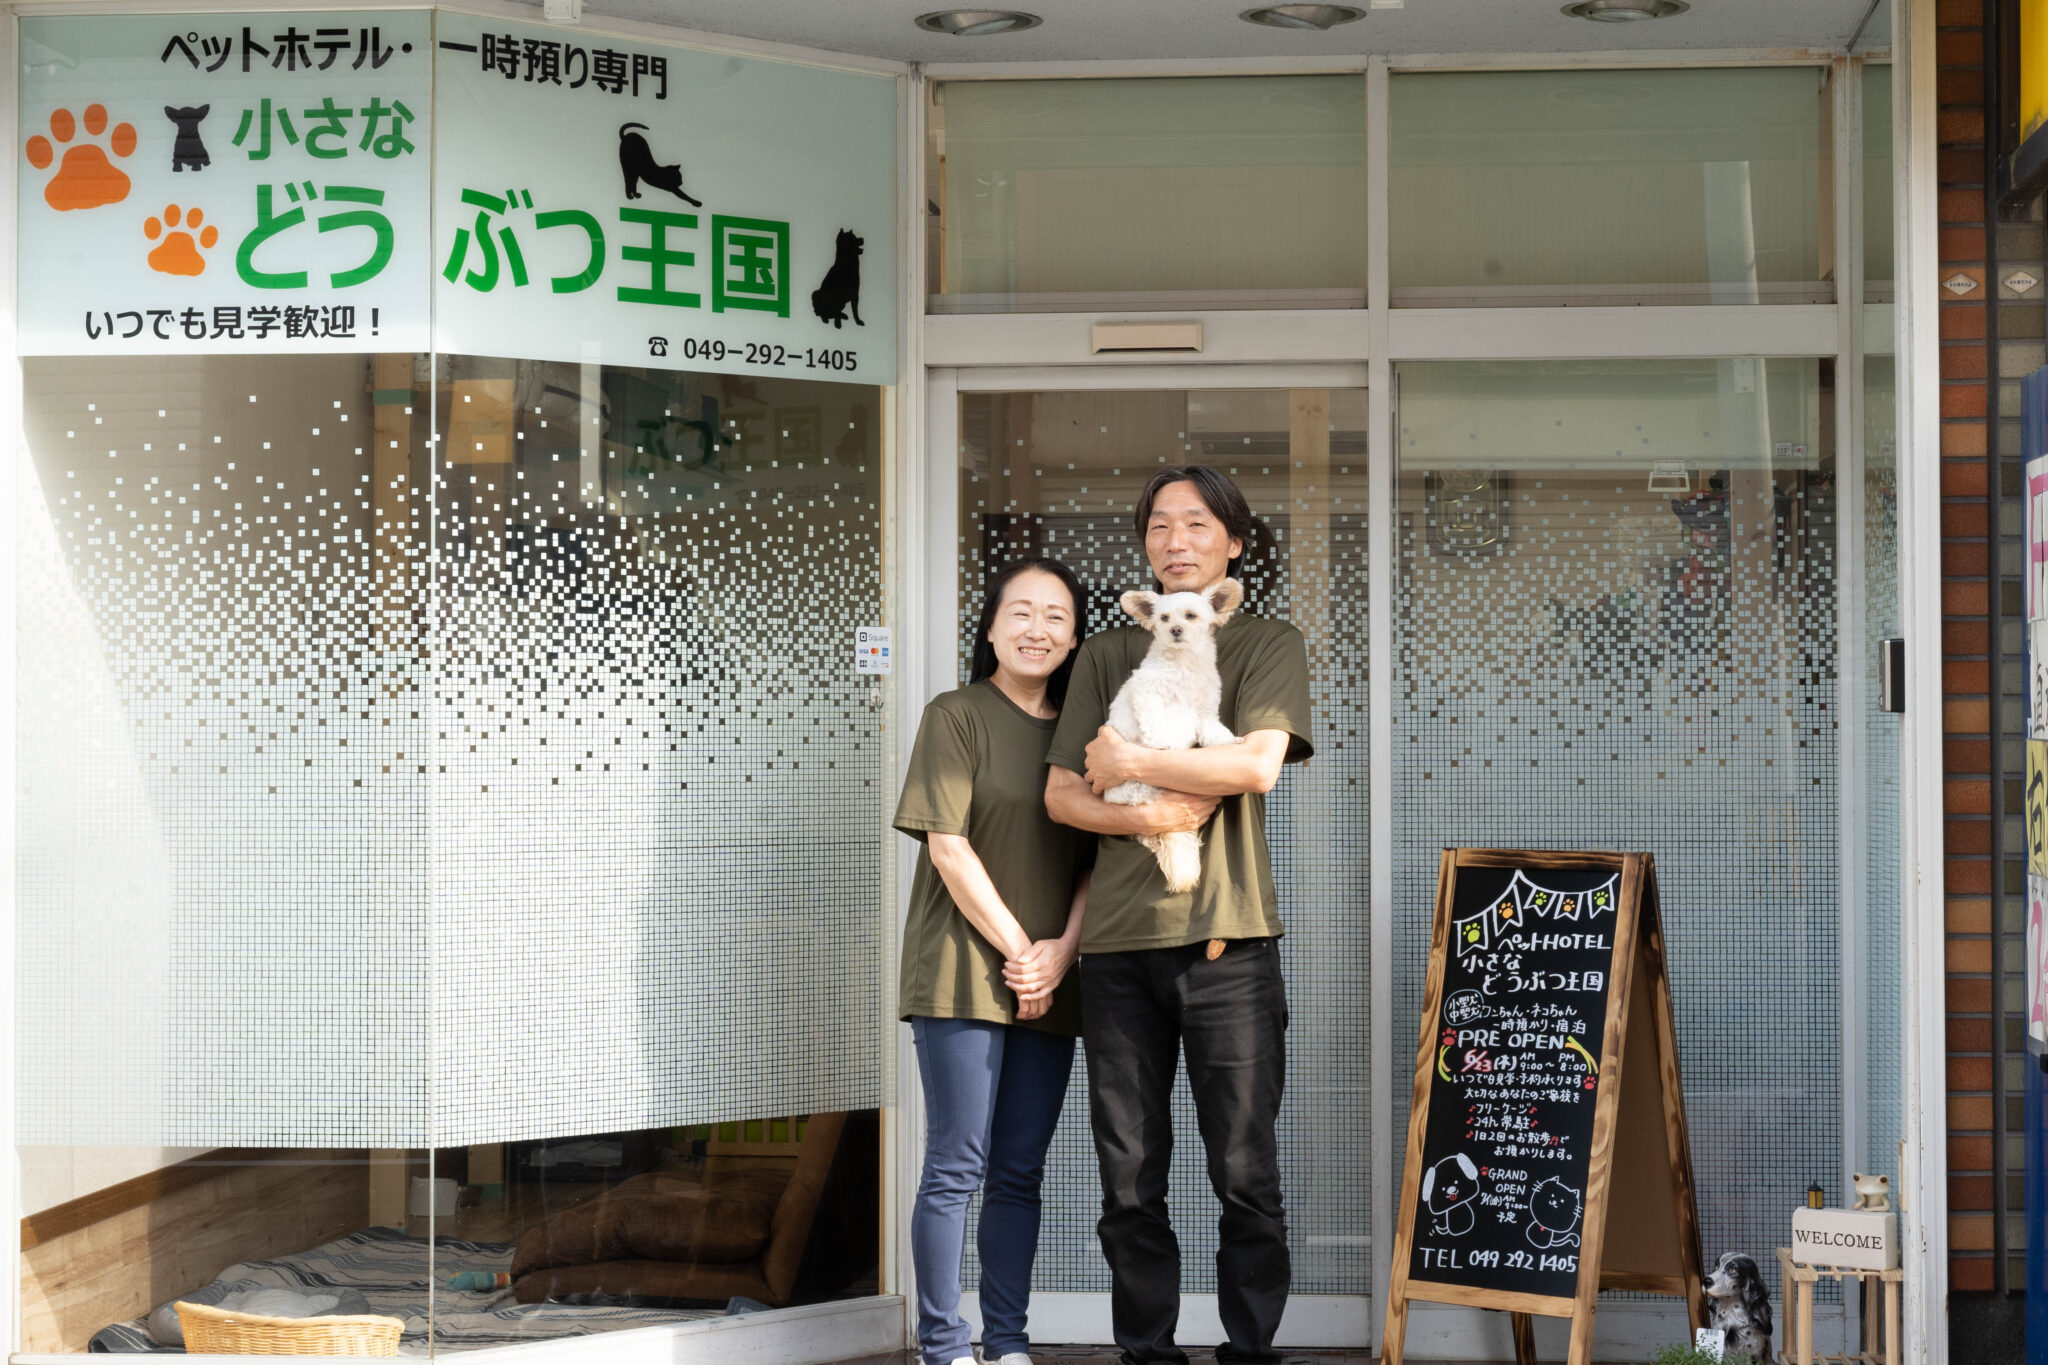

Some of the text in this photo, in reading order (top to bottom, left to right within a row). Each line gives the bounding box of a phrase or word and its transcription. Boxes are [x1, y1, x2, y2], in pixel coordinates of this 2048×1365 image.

[231, 97, 416, 161] 小さな
[85, 304, 381, 340] いつでも見学歓迎！
[1497, 932, 1611, 952] ペットHOTEL
[1461, 953, 1523, 974] 小さな
[1482, 970, 1604, 996] どうぶつ王国
[1448, 993, 1479, 1010] 小型犬
[1449, 1004, 1480, 1023] 中型犬
[1458, 1029, 1565, 1050] PRE OPEN
[1519, 1052, 1575, 1062] AM PM
[1475, 1102, 1531, 1115] フリーケージ
[1488, 1167, 1528, 1181] GRAND
[1495, 1183, 1526, 1196] OPEN
[1496, 1211, 1518, 1224] 予定
[1795, 1229, 1883, 1251] WELCOME
[1419, 1247, 1580, 1273] TEL 049 292 1405
